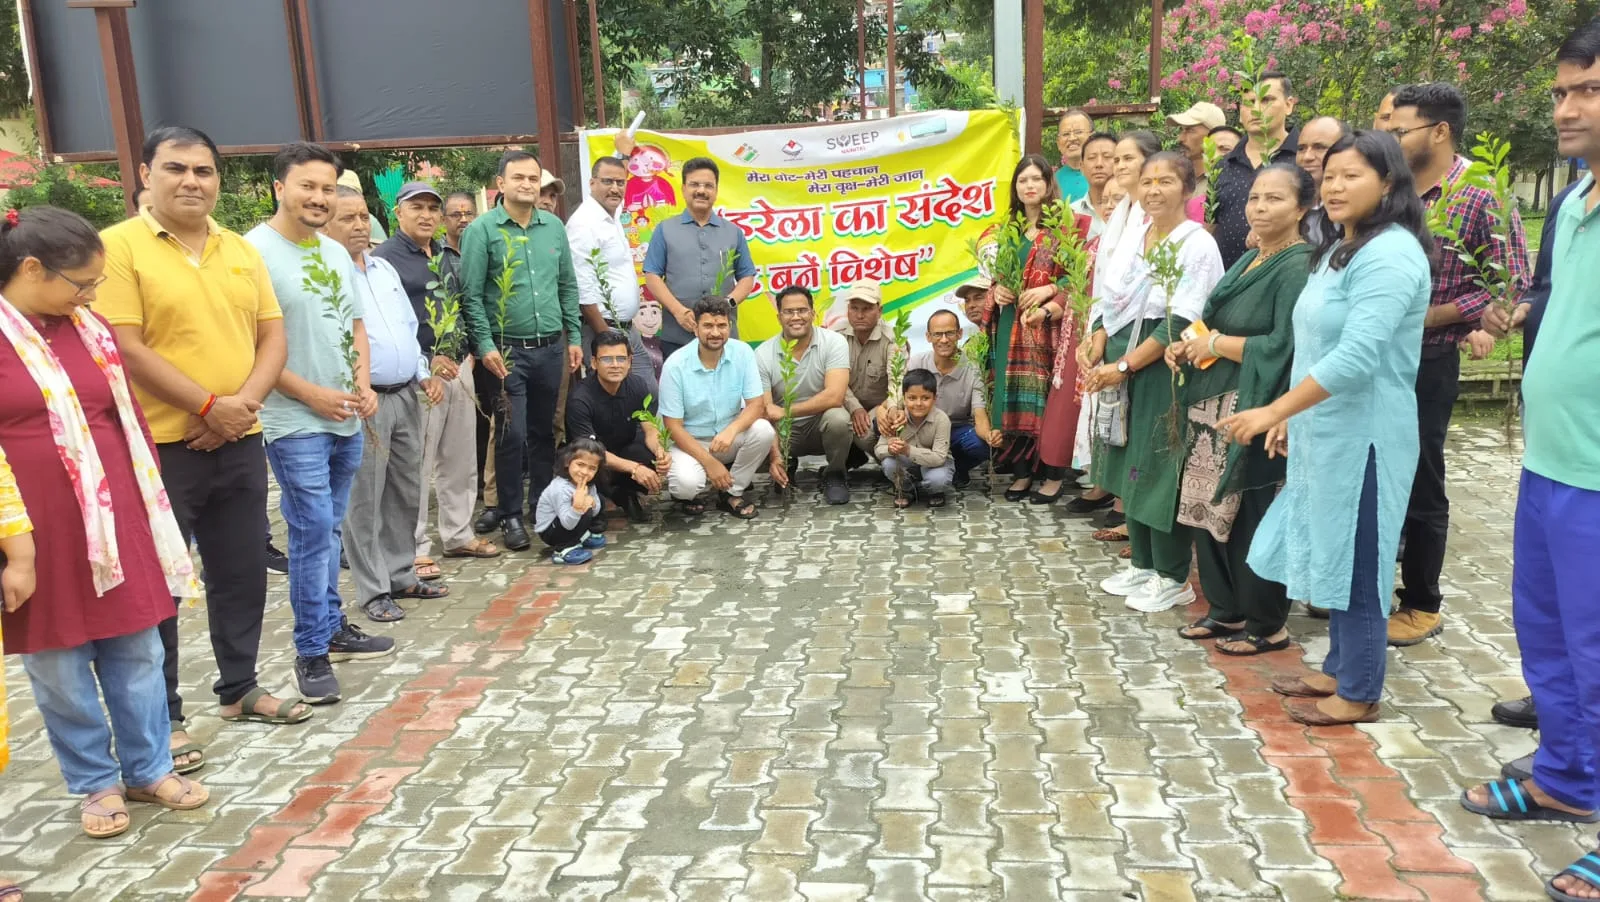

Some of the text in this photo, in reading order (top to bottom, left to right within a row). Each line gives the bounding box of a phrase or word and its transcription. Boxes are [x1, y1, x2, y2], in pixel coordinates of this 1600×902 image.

[826, 131, 879, 150] SWEEP
[747, 170, 770, 182] मेरा
[831, 165, 879, 178] पहचान
[808, 181, 831, 193] मेरा
[894, 169, 924, 182] जान
[832, 199, 887, 231] का
[897, 178, 994, 224] संदेश
